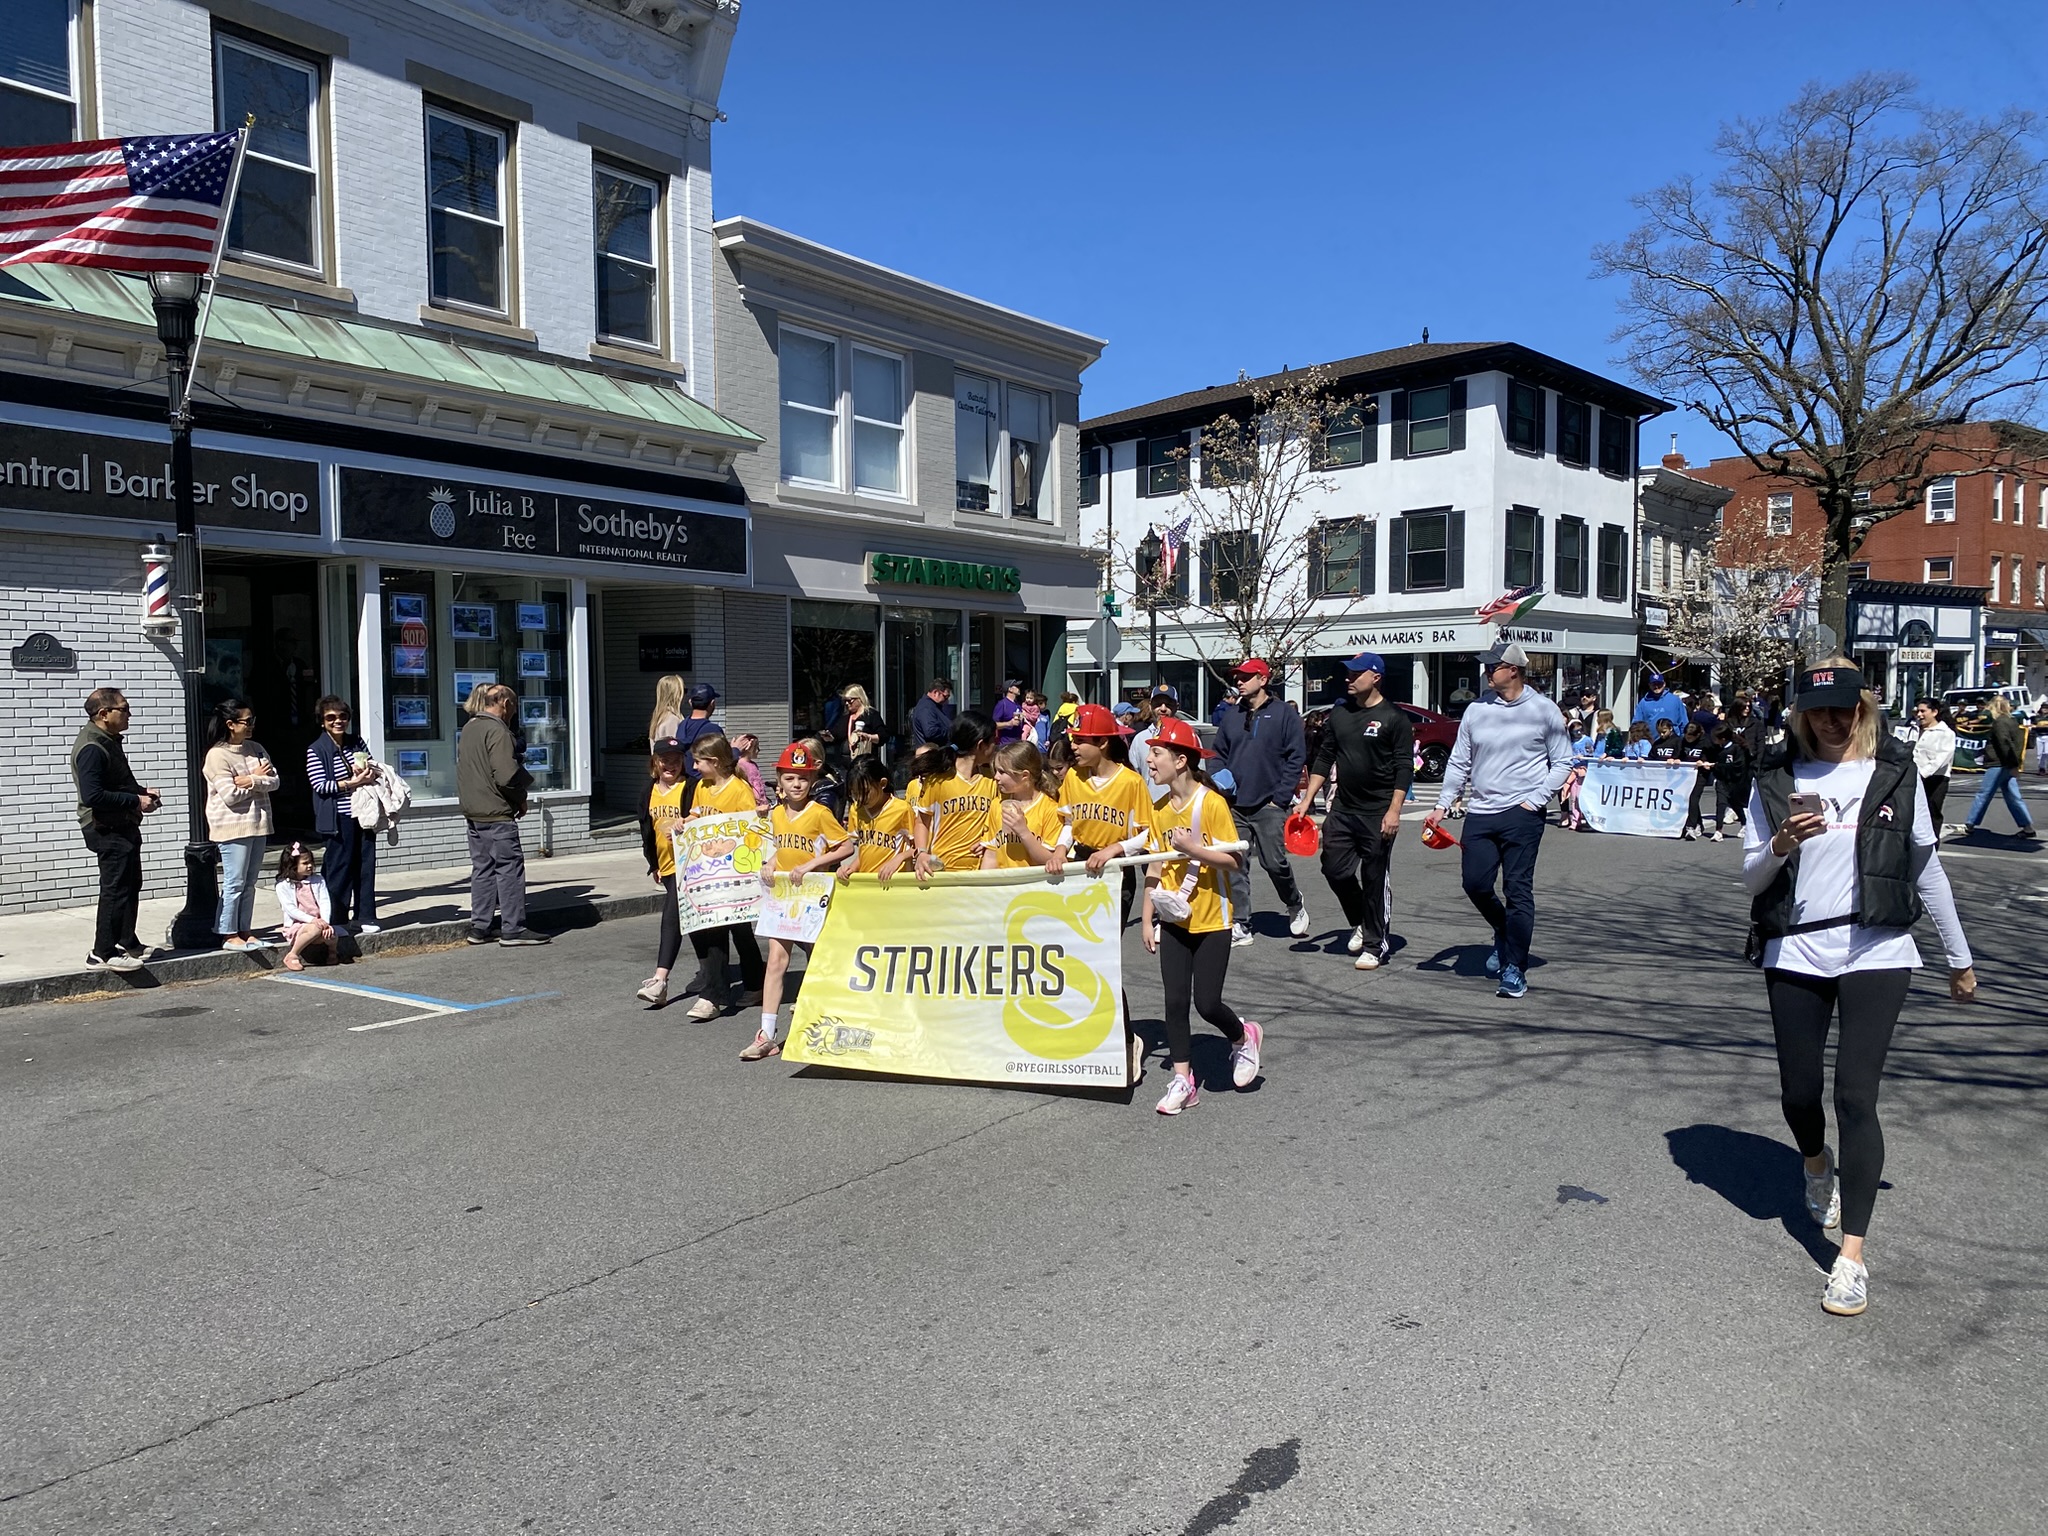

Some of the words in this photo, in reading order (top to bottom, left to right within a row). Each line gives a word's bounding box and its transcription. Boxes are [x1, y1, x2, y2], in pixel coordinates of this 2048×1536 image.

[231, 473, 309, 521] Shop
[467, 490, 514, 517] Julia
[520, 495, 536, 519] B
[502, 525, 536, 550] Fee
[578, 504, 688, 550] Sotheby's
[579, 543, 654, 561] INTERNATIONAL
[656, 552, 688, 563] REALTY
[872, 553, 1022, 593] STARBUCKS
[34, 639, 50, 651] 49
[1346, 634, 1377, 646] ANNA
[1380, 631, 1424, 644] MARIA'S
[1432, 630, 1456, 642] BAR
[1813, 671, 1834, 682] RYE
[1601, 784, 1674, 811] VIPERS
[849, 945, 1065, 996] STRIKERS
[832, 1026, 875, 1049] RYE
[1005, 1061, 1122, 1076] @RYEGIRLSSOFTBALL
